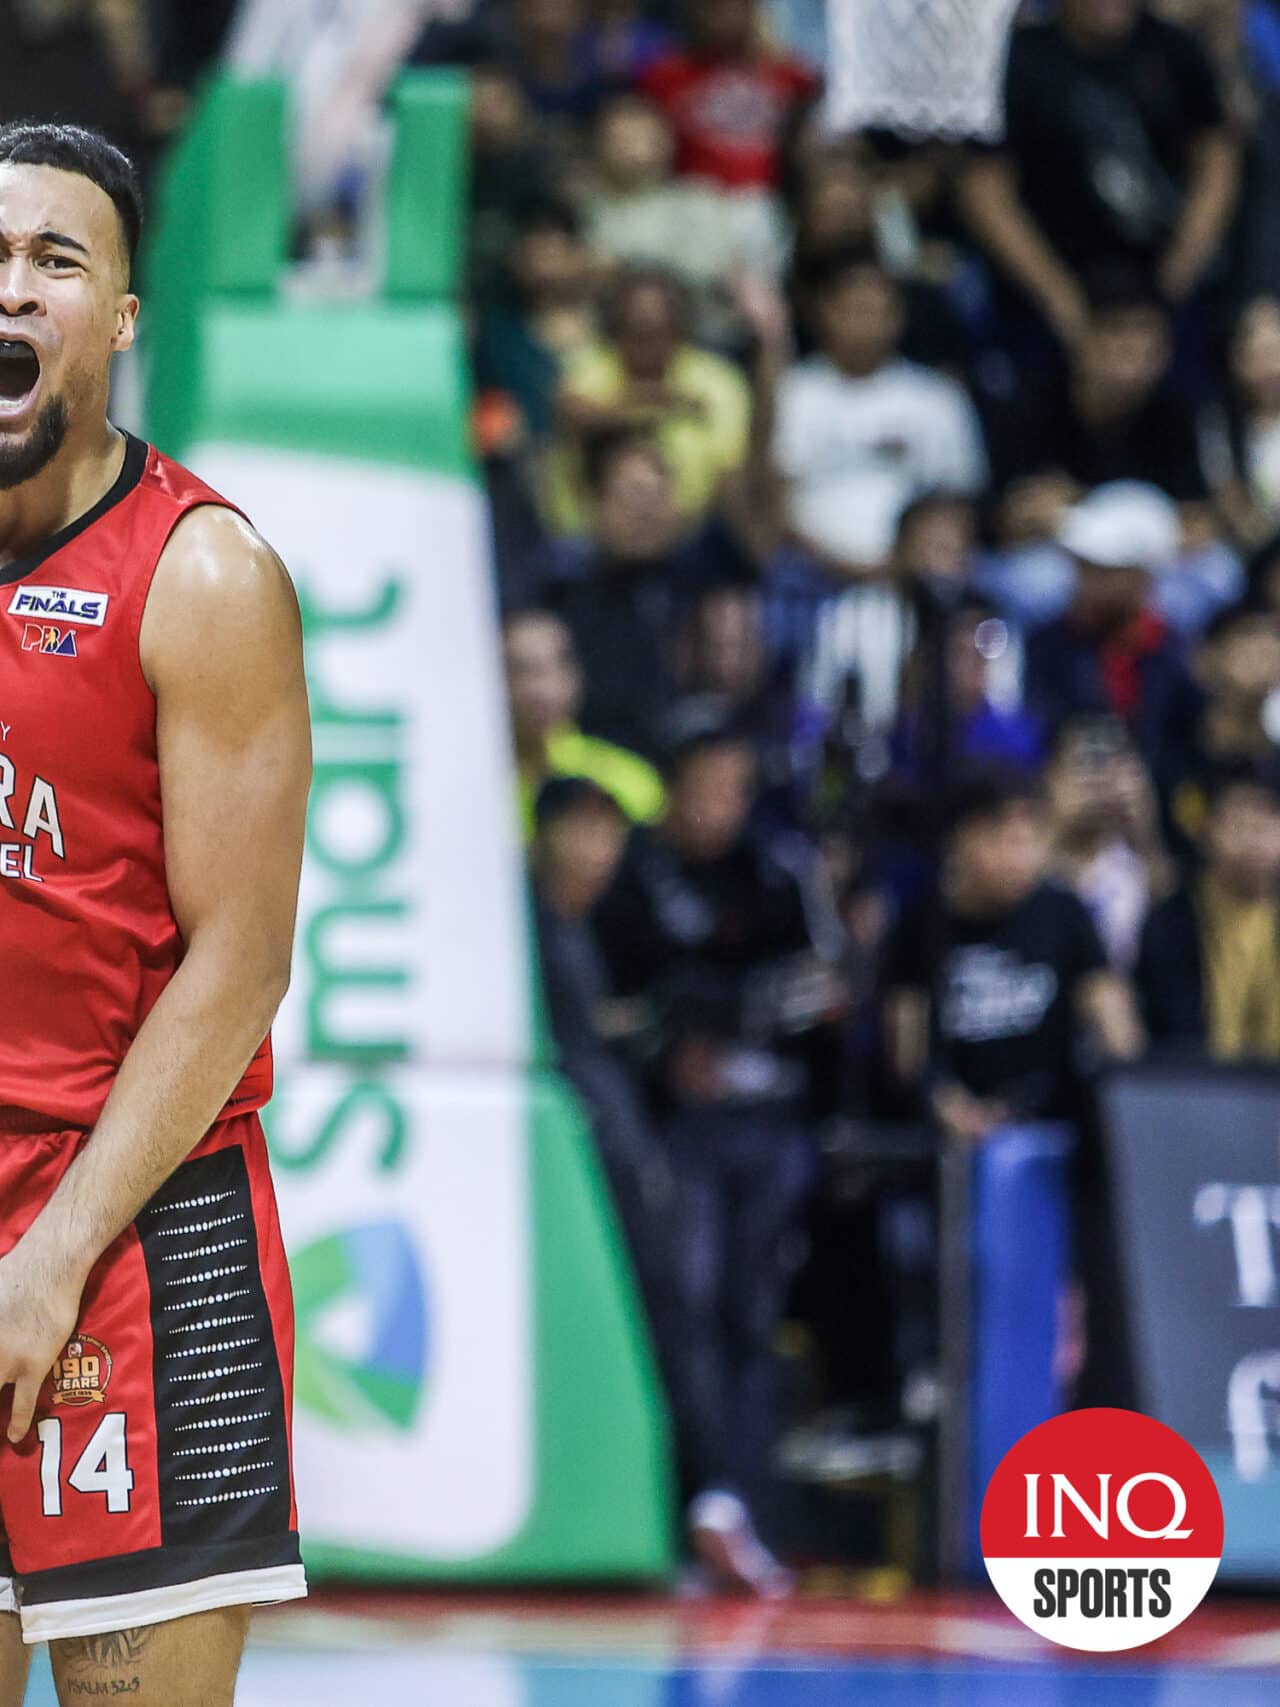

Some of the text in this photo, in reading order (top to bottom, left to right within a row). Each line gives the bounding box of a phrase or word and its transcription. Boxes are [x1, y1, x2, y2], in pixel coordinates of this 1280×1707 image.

[16, 594, 101, 619] FINALS
[52, 591, 67, 599] THE
[266, 574, 407, 1174] smart
[54, 1376, 99, 1391] YEARS
[35, 1411, 136, 1517] 14
